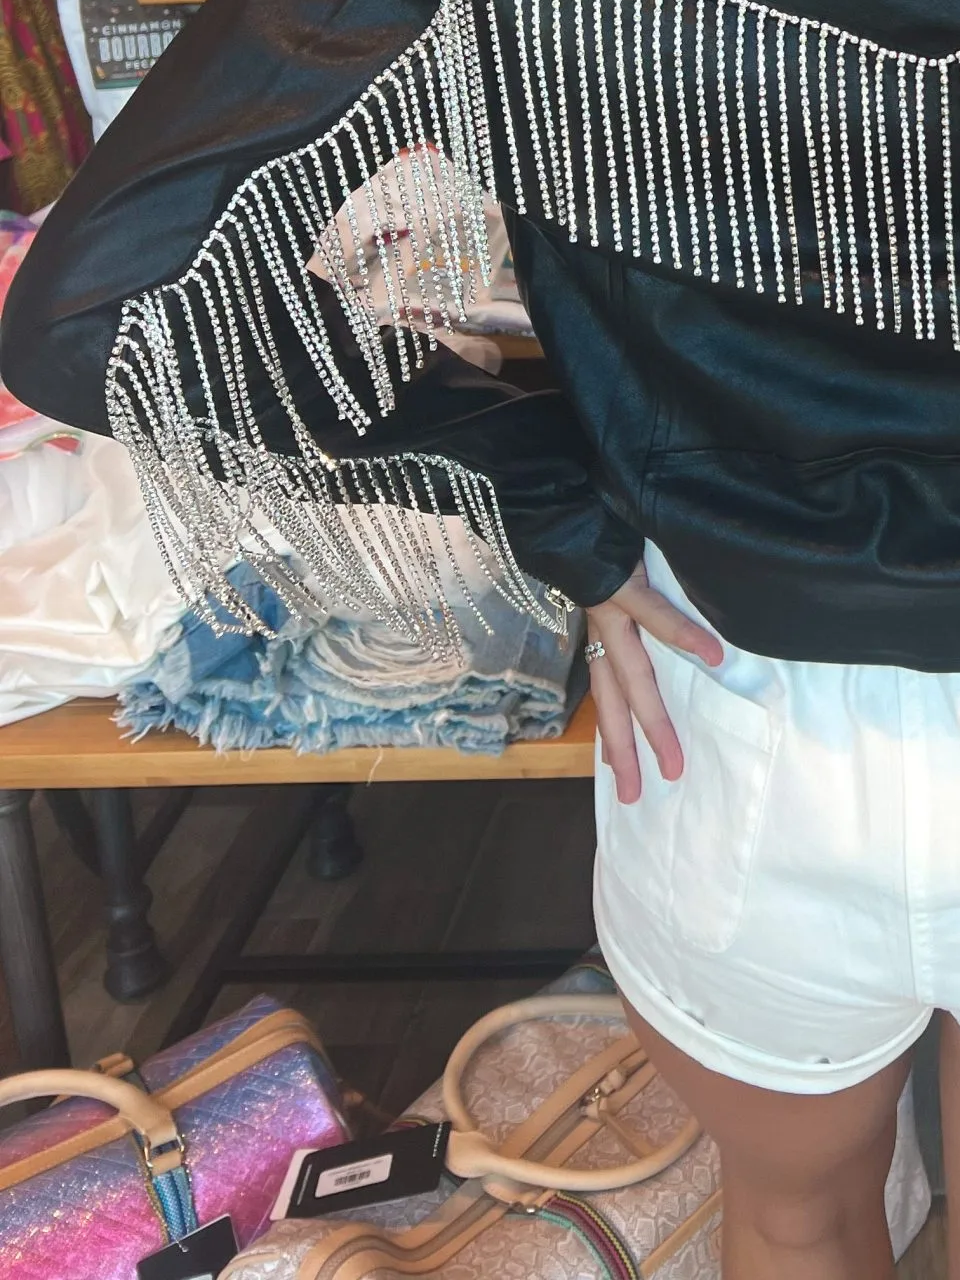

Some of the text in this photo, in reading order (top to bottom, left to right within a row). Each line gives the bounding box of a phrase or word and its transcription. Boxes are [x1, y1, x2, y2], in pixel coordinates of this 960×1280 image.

[102, 19, 182, 36] CINNAMON
[98, 29, 180, 63] BOURBO
[125, 58, 157, 70] PECA
